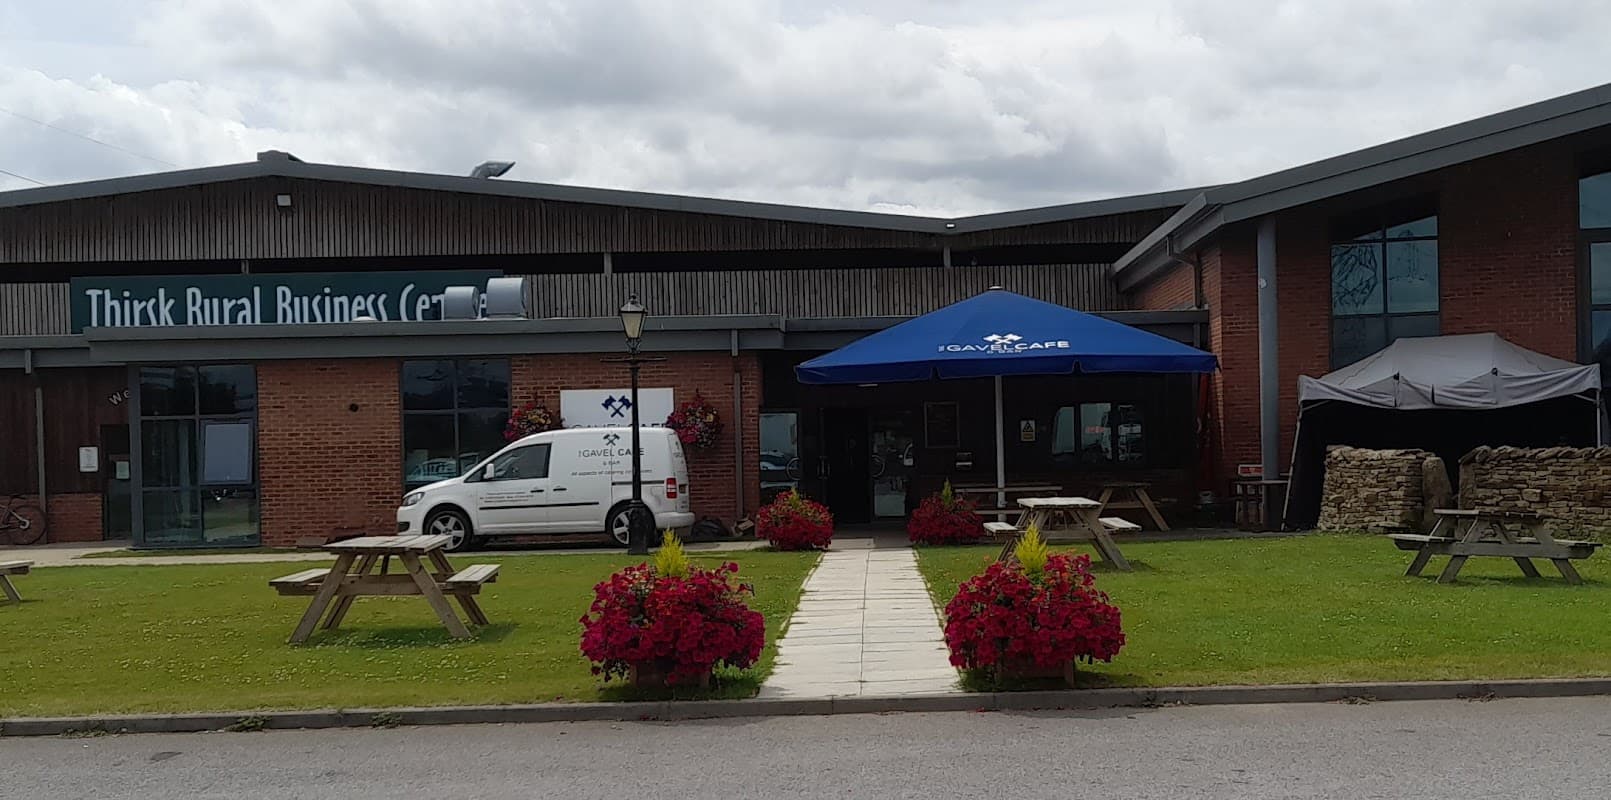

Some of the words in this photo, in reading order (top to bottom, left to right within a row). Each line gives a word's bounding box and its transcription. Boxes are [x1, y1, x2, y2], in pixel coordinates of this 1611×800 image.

[85, 287, 175, 327] Thirsk
[186, 286, 261, 326] Rural
[276, 285, 387, 324] Business
[582, 448, 615, 458] GAVEL
[617, 447, 645, 457] CAE
